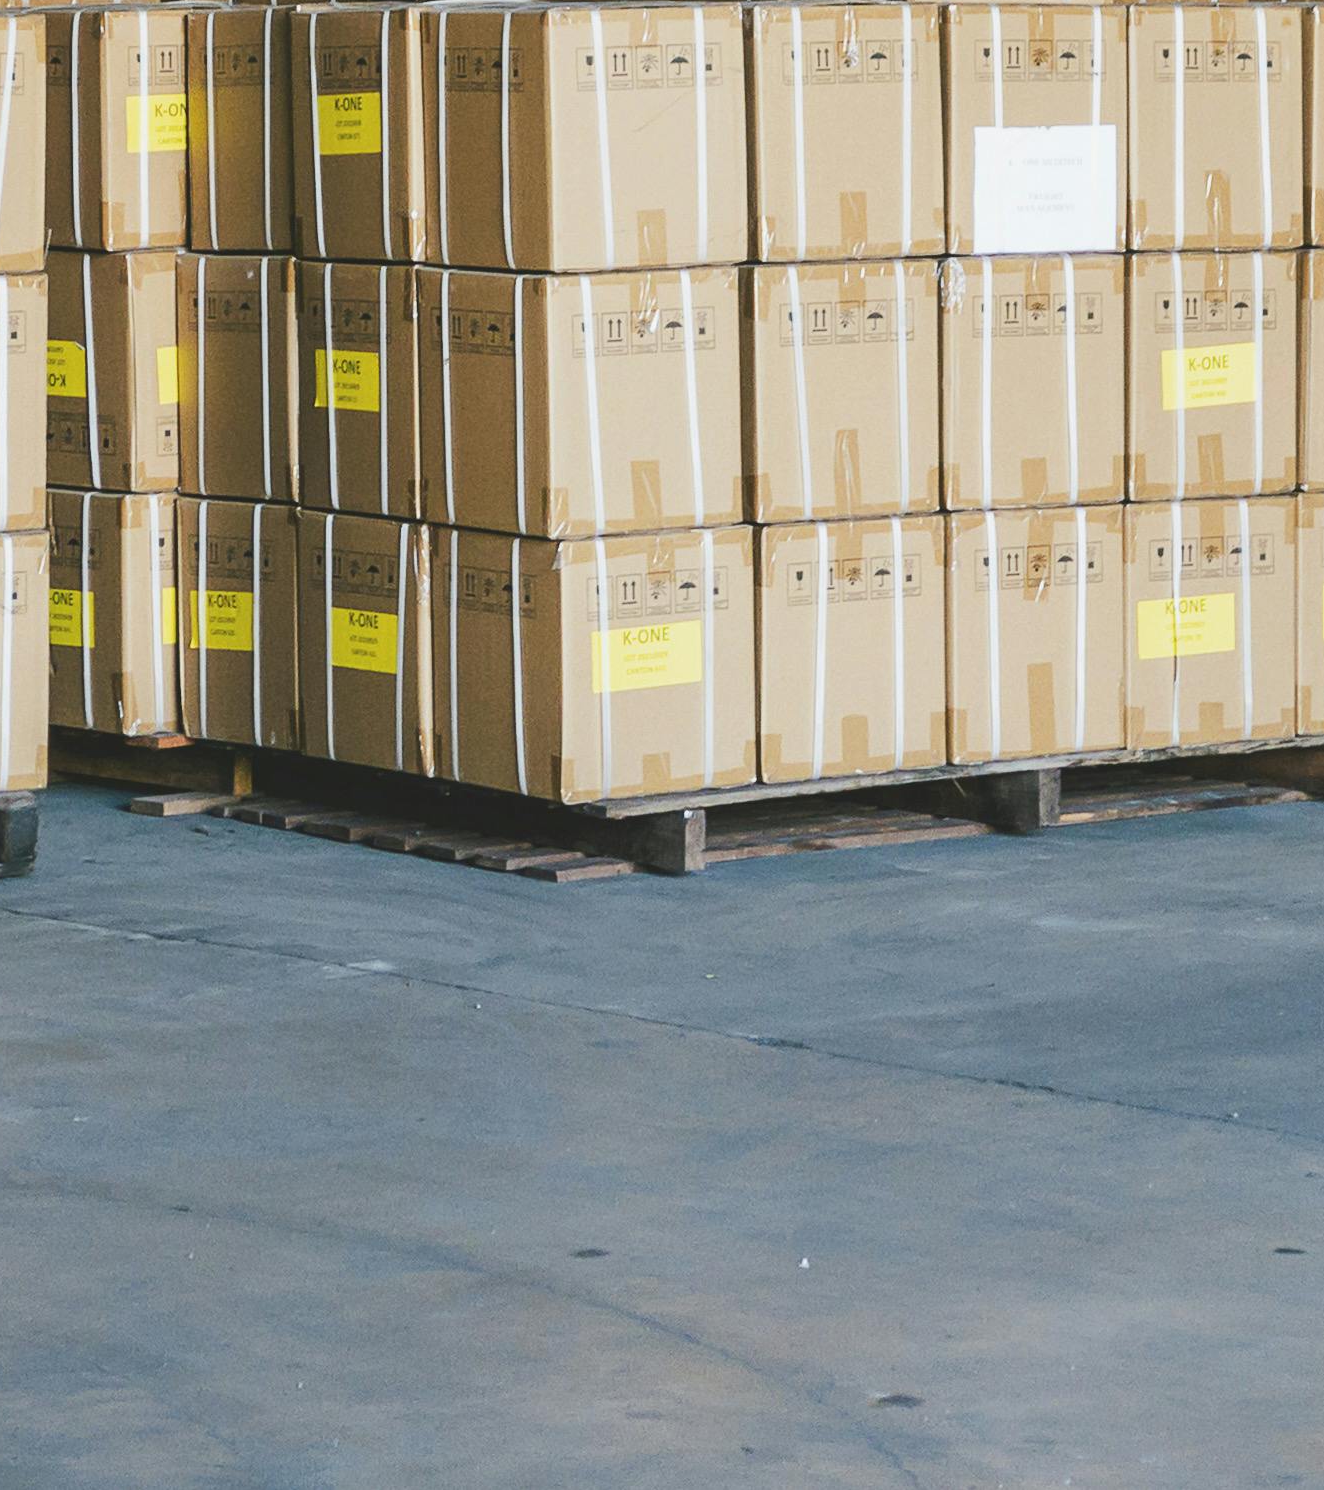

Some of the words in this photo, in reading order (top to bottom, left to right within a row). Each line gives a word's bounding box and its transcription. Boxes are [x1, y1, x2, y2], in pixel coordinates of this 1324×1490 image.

[155, 103, 186, 117] K-ON
[334, 97, 362, 112] K-ONE
[1187, 354, 1230, 371] K-ONE
[50, 591, 74, 606] -ONE
[207, 593, 238, 609] K-ONE
[348, 611, 379, 630] K-ONE
[623, 626, 670, 646] K-ONE
